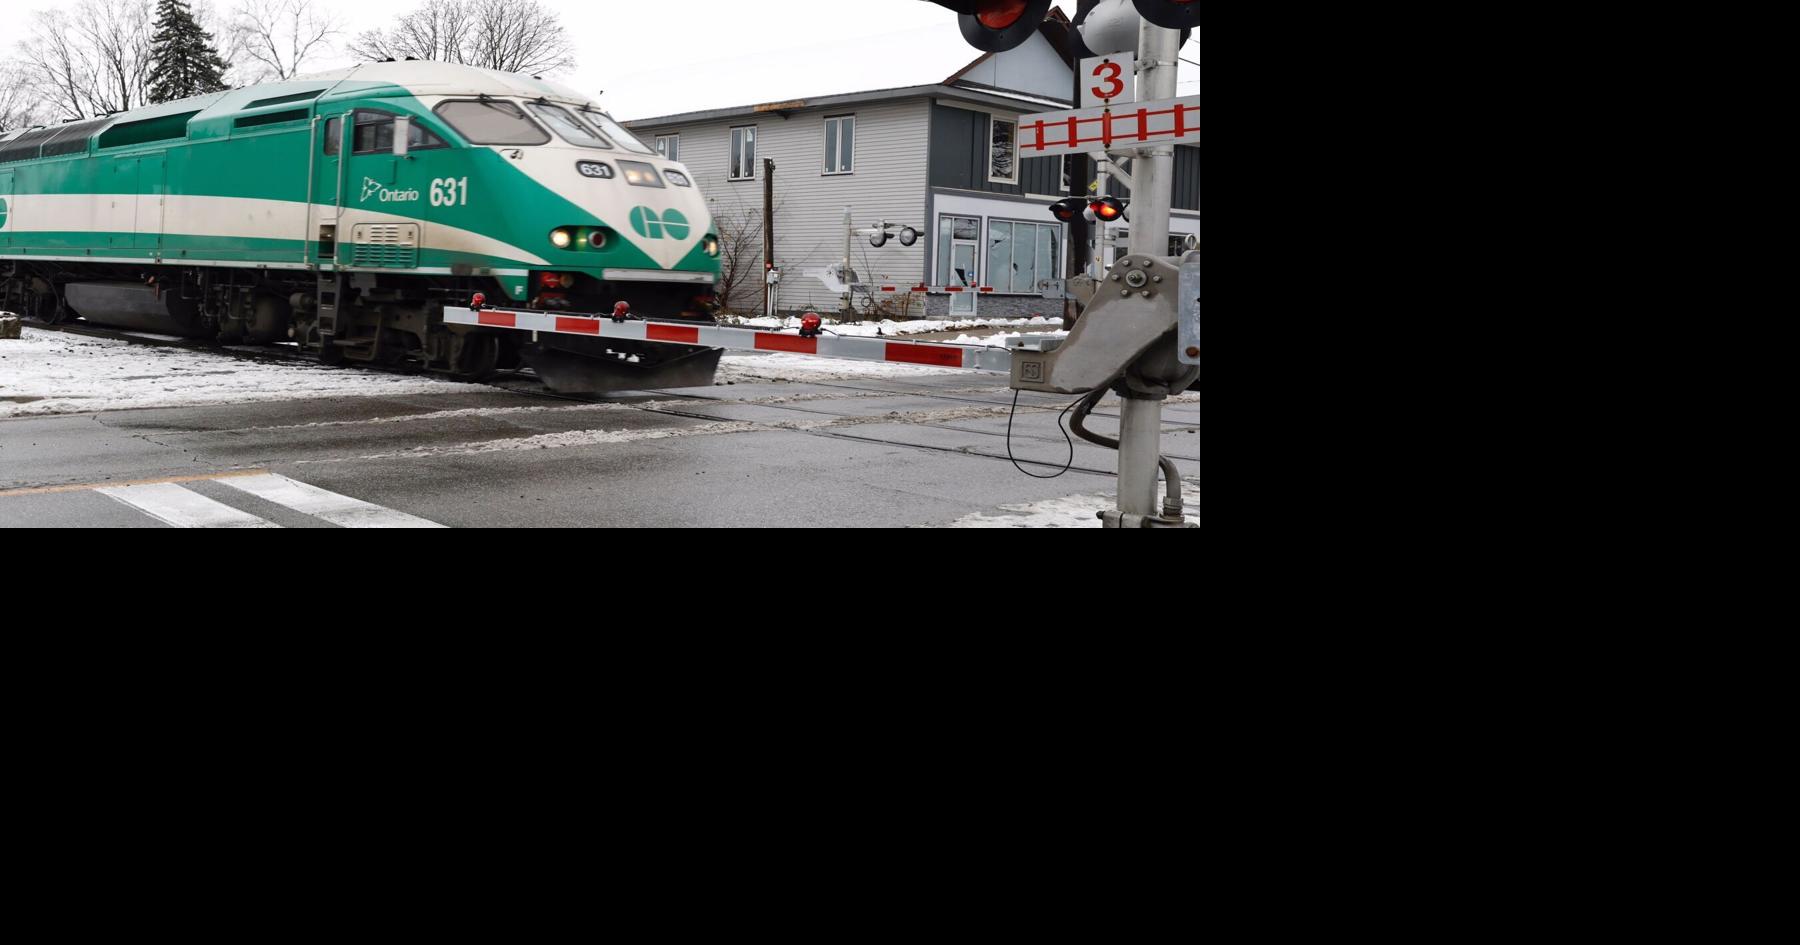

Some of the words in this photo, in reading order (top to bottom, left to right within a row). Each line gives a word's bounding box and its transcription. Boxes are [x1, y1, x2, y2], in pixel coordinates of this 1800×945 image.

[1091, 62, 1124, 98] 3
[580, 163, 611, 177] 631
[379, 188, 419, 202] Ontario
[429, 177, 468, 207] 631
[629, 206, 691, 241] GO
[515, 285, 524, 295] F
